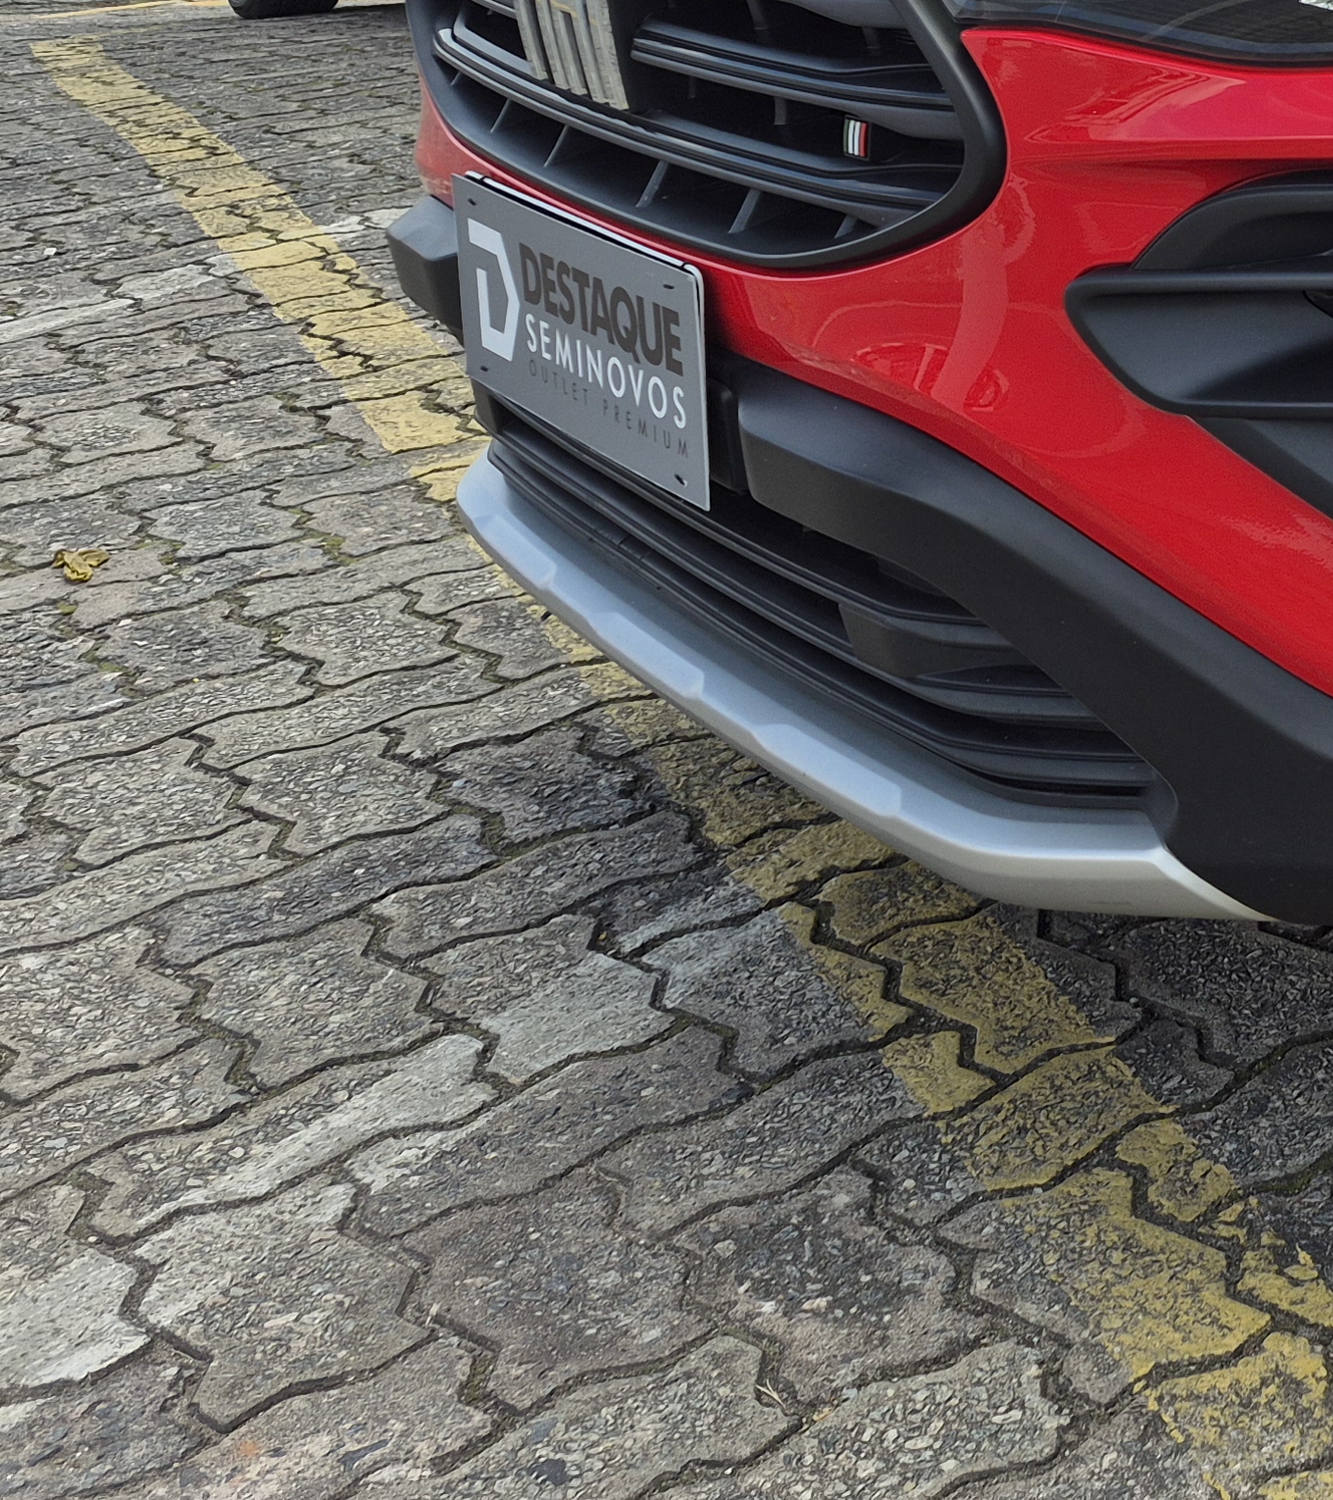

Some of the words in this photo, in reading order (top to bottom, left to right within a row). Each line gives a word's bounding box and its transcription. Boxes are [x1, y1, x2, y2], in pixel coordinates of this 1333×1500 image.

[519, 242, 684, 377] DESTAQUE
[524, 313, 687, 429] SEMINOVOS
[528, 358, 589, 406] OUTLET
[602, 398, 690, 459] PREMIUM
